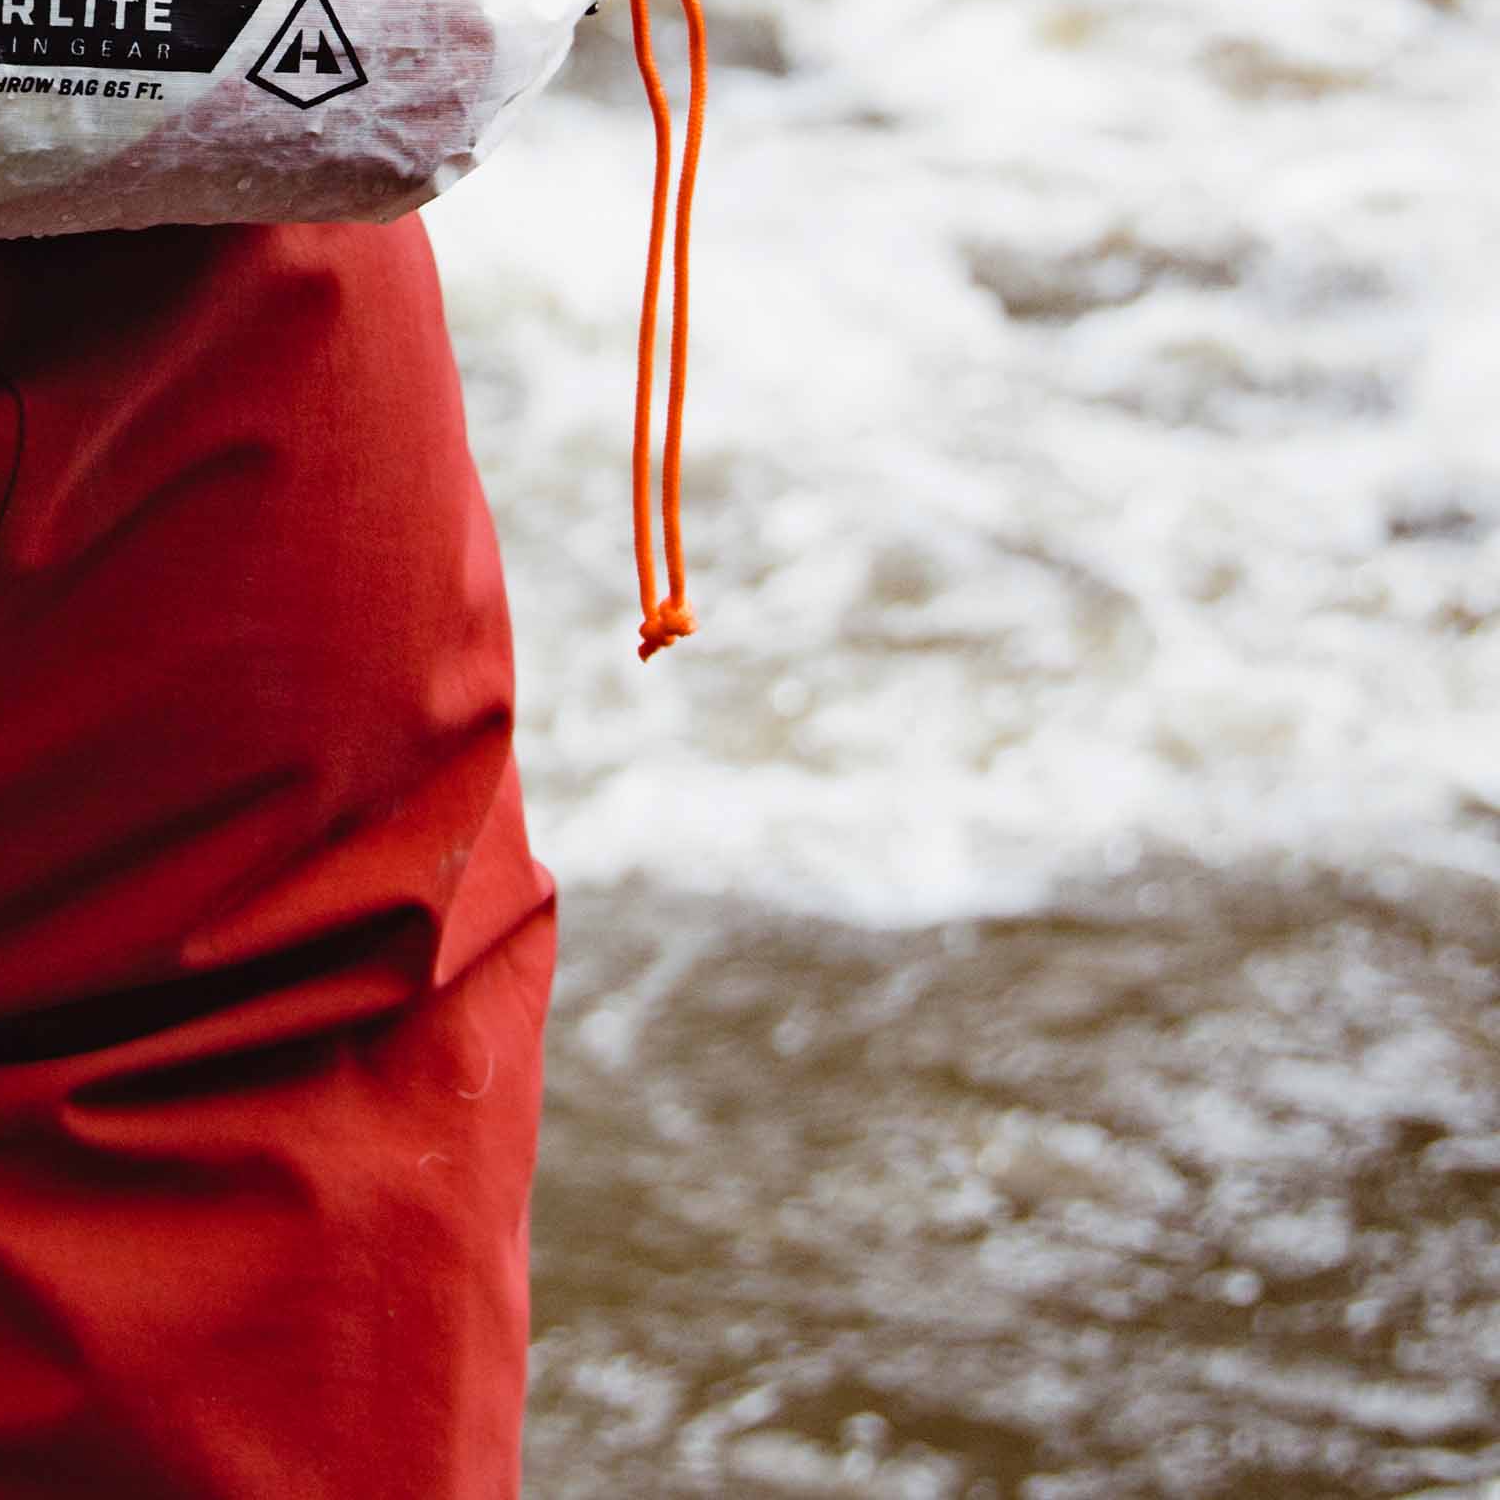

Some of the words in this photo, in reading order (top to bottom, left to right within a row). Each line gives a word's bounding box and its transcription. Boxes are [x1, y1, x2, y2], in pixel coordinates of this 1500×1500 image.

[71, 38, 171, 59] GEAR
[58, 79, 99, 97] BAG
[103, 81, 130, 99] 65
[135, 82, 163, 100] FT.
